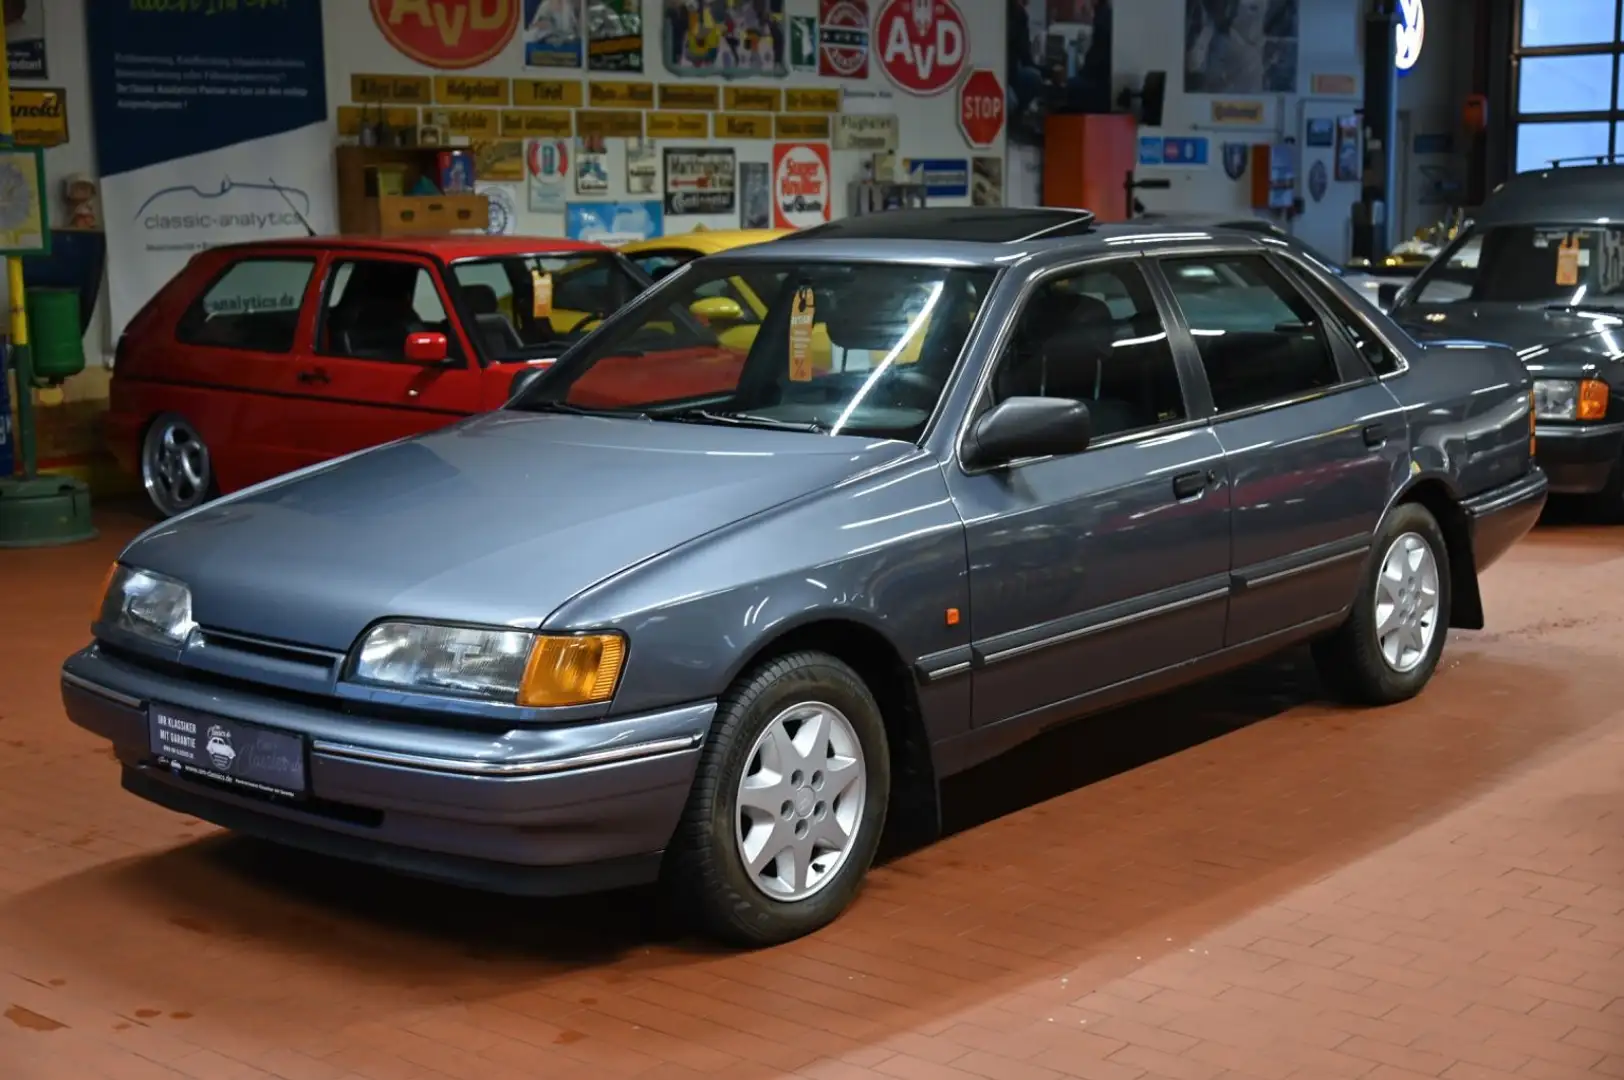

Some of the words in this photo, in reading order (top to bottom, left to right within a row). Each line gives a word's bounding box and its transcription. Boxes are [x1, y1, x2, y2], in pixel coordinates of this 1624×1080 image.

[884, 16, 963, 81] AvD
[967, 96, 1002, 121] STOP
[168, 716, 197, 735] KLASSIKER
[160, 728, 169, 743] MIT
[171, 731, 196, 749] GARANTIE
